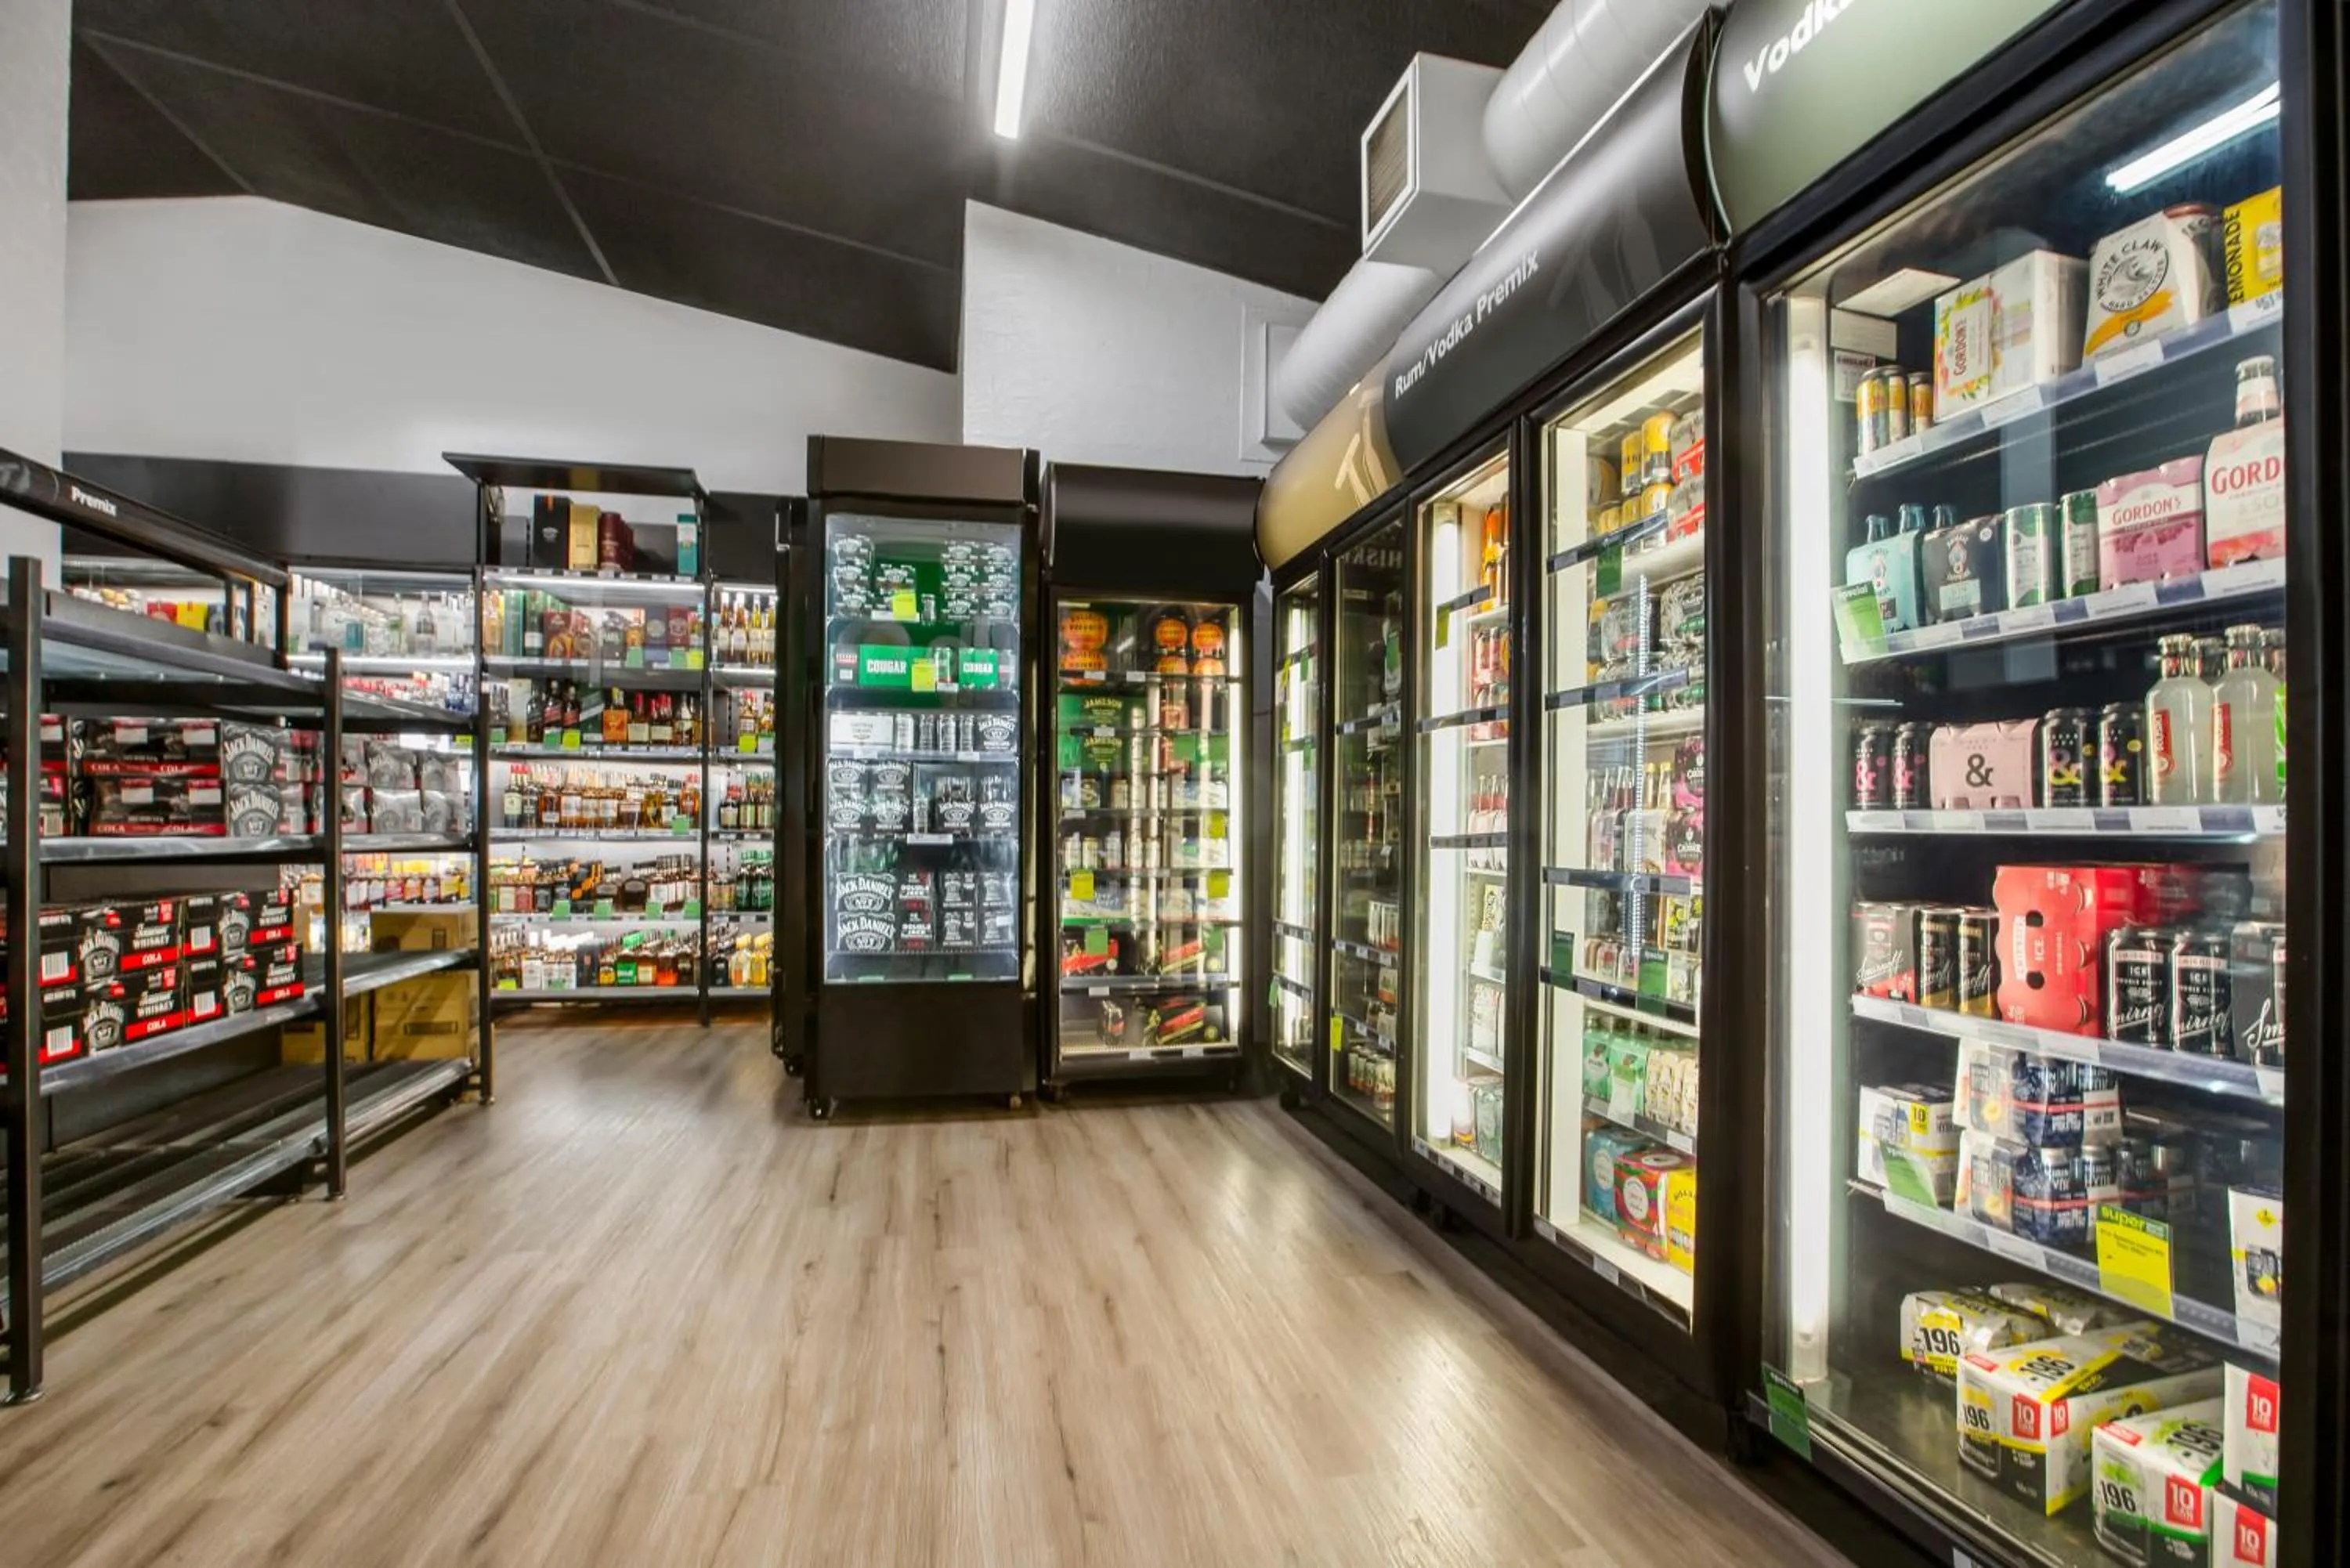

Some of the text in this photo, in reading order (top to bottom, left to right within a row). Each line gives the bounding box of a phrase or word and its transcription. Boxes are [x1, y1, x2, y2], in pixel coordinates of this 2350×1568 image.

[2225, 209, 2244, 304] EMONADE
[2095, 238, 2164, 301] WHITE CLAW
[1395, 249, 1539, 399] Rum/Vodka Premix
[70, 486, 118, 517] Premix
[2111, 496, 2182, 526] GORDON'S
[866, 659, 908, 674] COUGAR
[1965, 753, 1994, 787] &
[132, 934, 170, 950] WHISKEY
[142, 952, 162, 966] COLA
[2130, 966, 2152, 977] ICE
[2189, 971, 2208, 985] ICE
[137, 1000, 175, 1018] WHISKEY
[146, 1019, 167, 1033] COLA
[1914, 1106, 1925, 1122] 10
[2101, 1205, 2146, 1232] super
[2017, 1400, 2035, 1427] 10
[2251, 1393, 2272, 1416] 10
[2169, 1482, 2195, 1512] 10
[2240, 1525, 2260, 1550] 10
